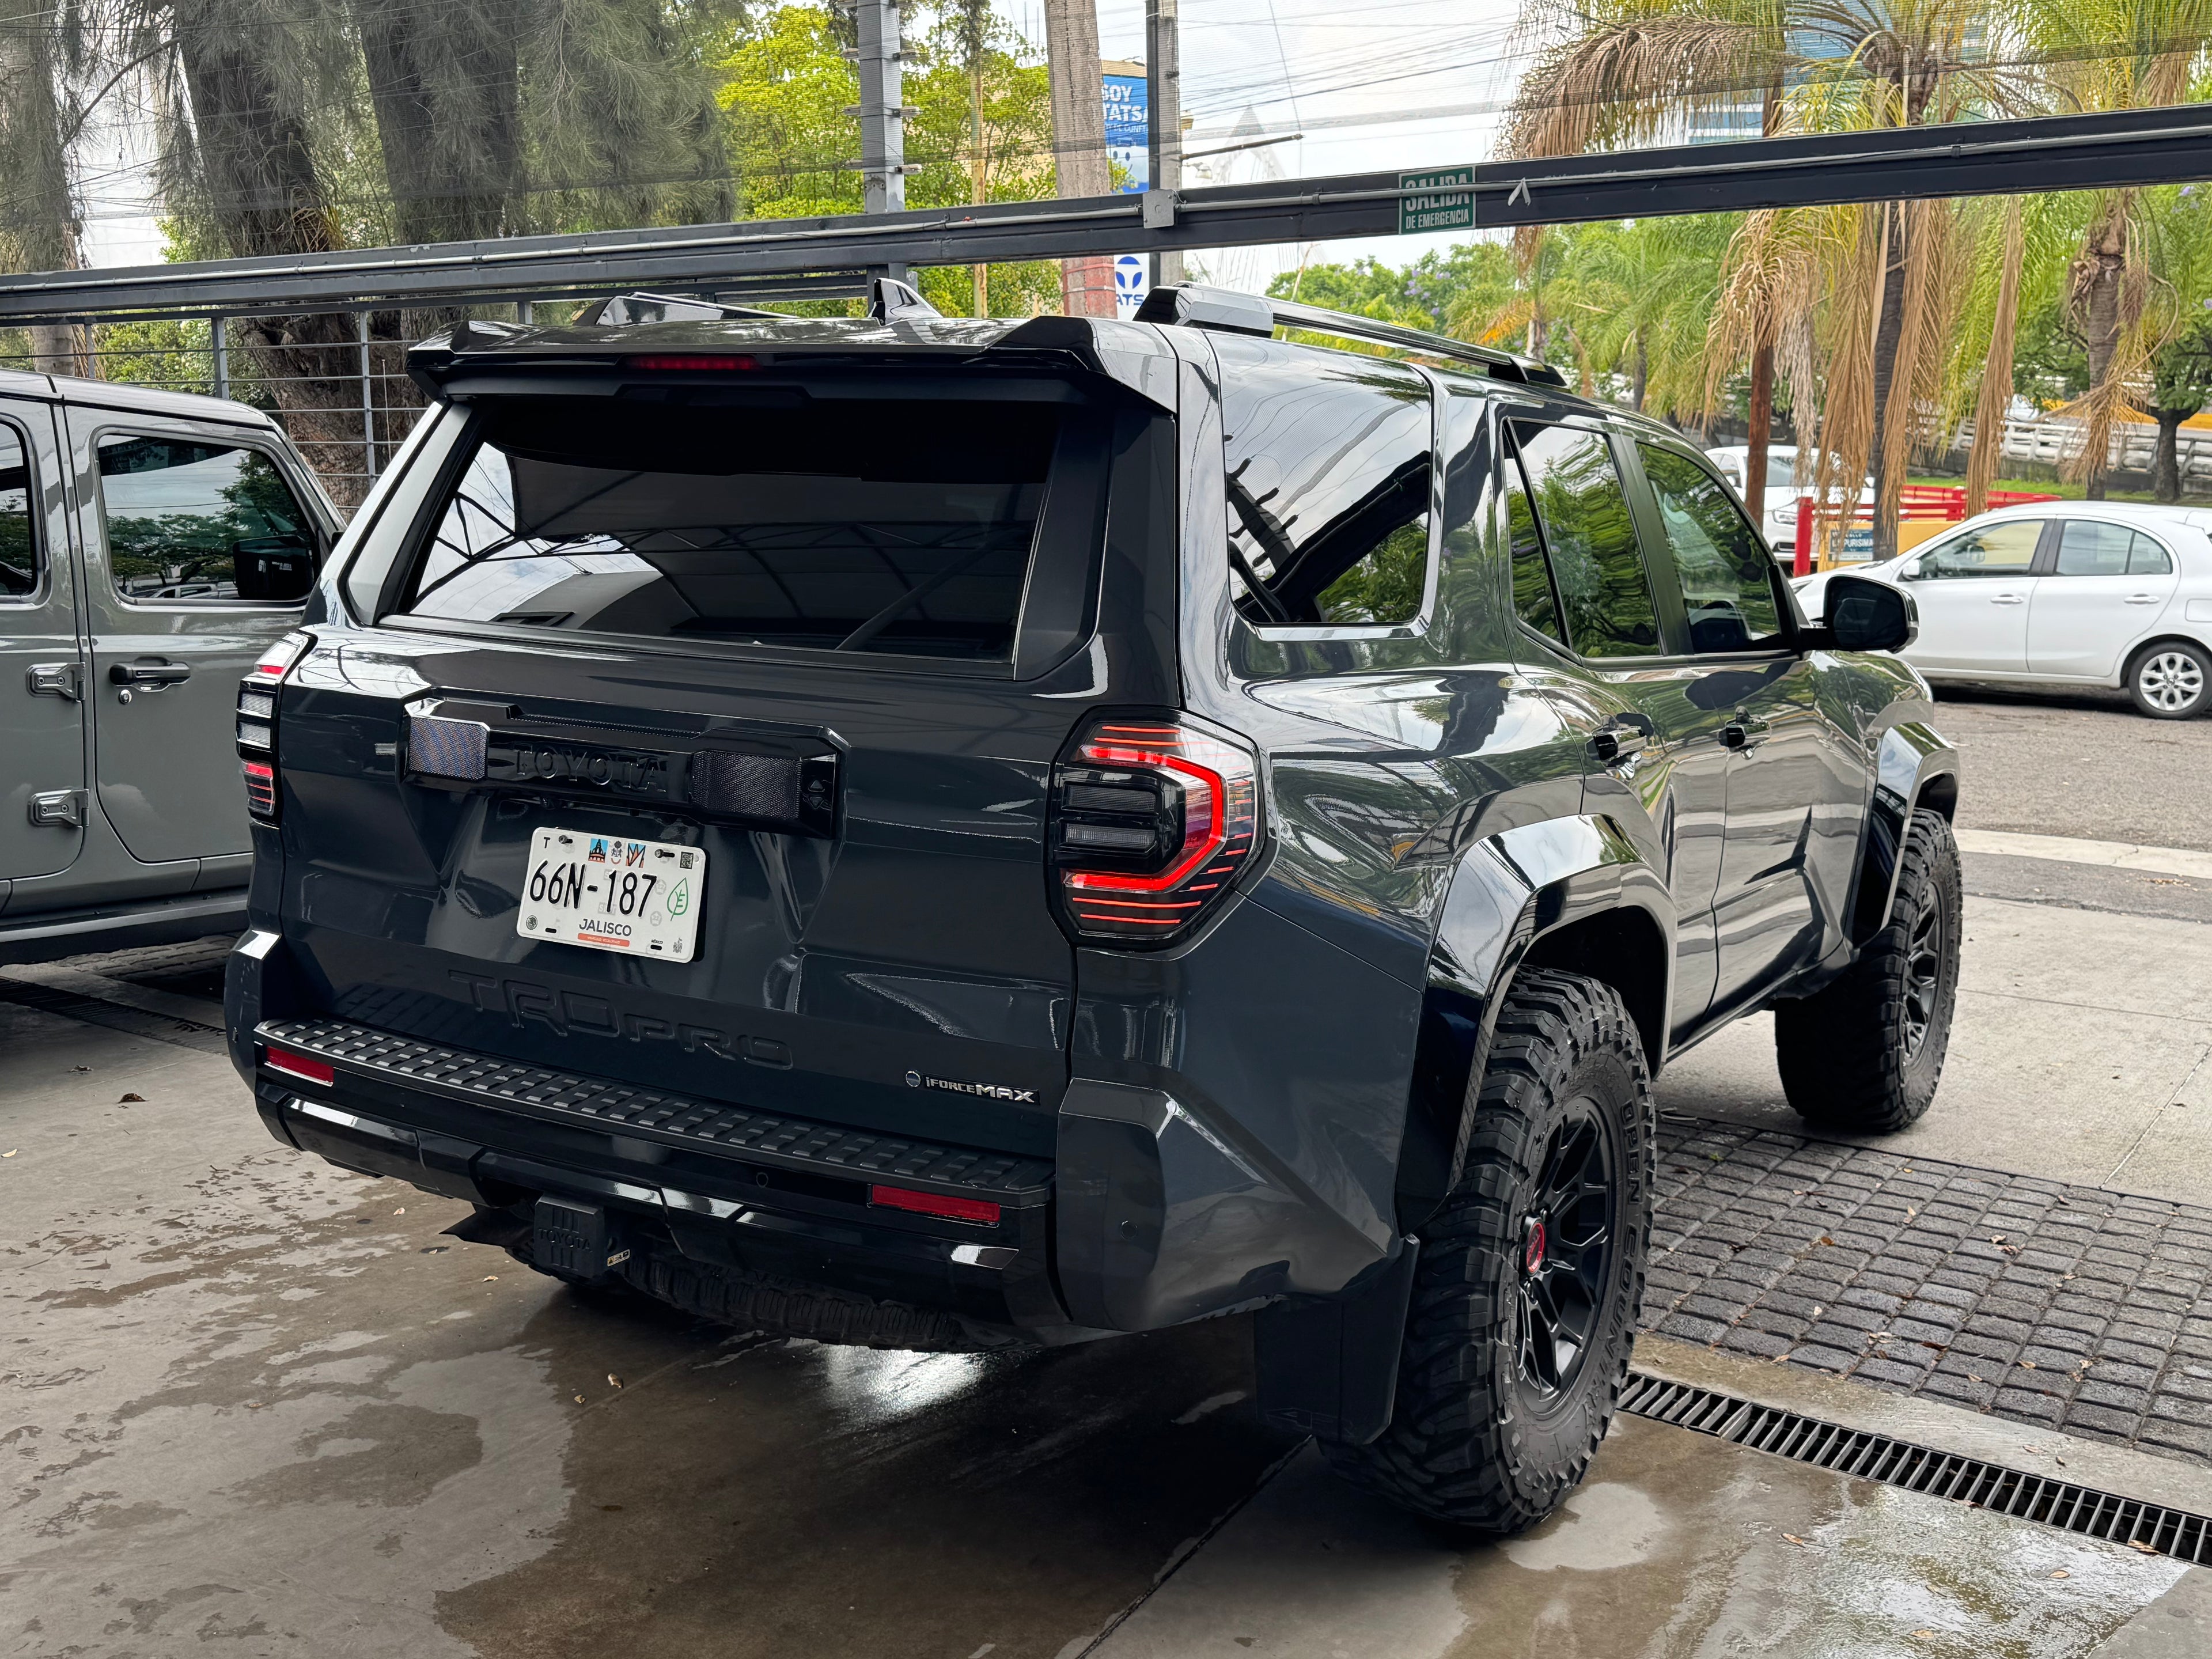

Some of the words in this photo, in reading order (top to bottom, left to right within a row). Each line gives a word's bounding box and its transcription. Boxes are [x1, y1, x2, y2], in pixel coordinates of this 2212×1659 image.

[1406, 173, 1469, 211] SALIDA
[1406, 215, 1416, 229] DE
[1418, 209, 1469, 228] EMERGENCIA
[516, 744, 667, 793] TOYOTA
[543, 836, 551, 849] T
[529, 859, 657, 918] 66N-187
[579, 918, 632, 937] JALISCO
[448, 969, 620, 1038] TRD
[624, 1013, 794, 1071] PRO
[1620, 1099, 1643, 1205] OPEN
[538, 1228, 593, 1253] TOYOTA
